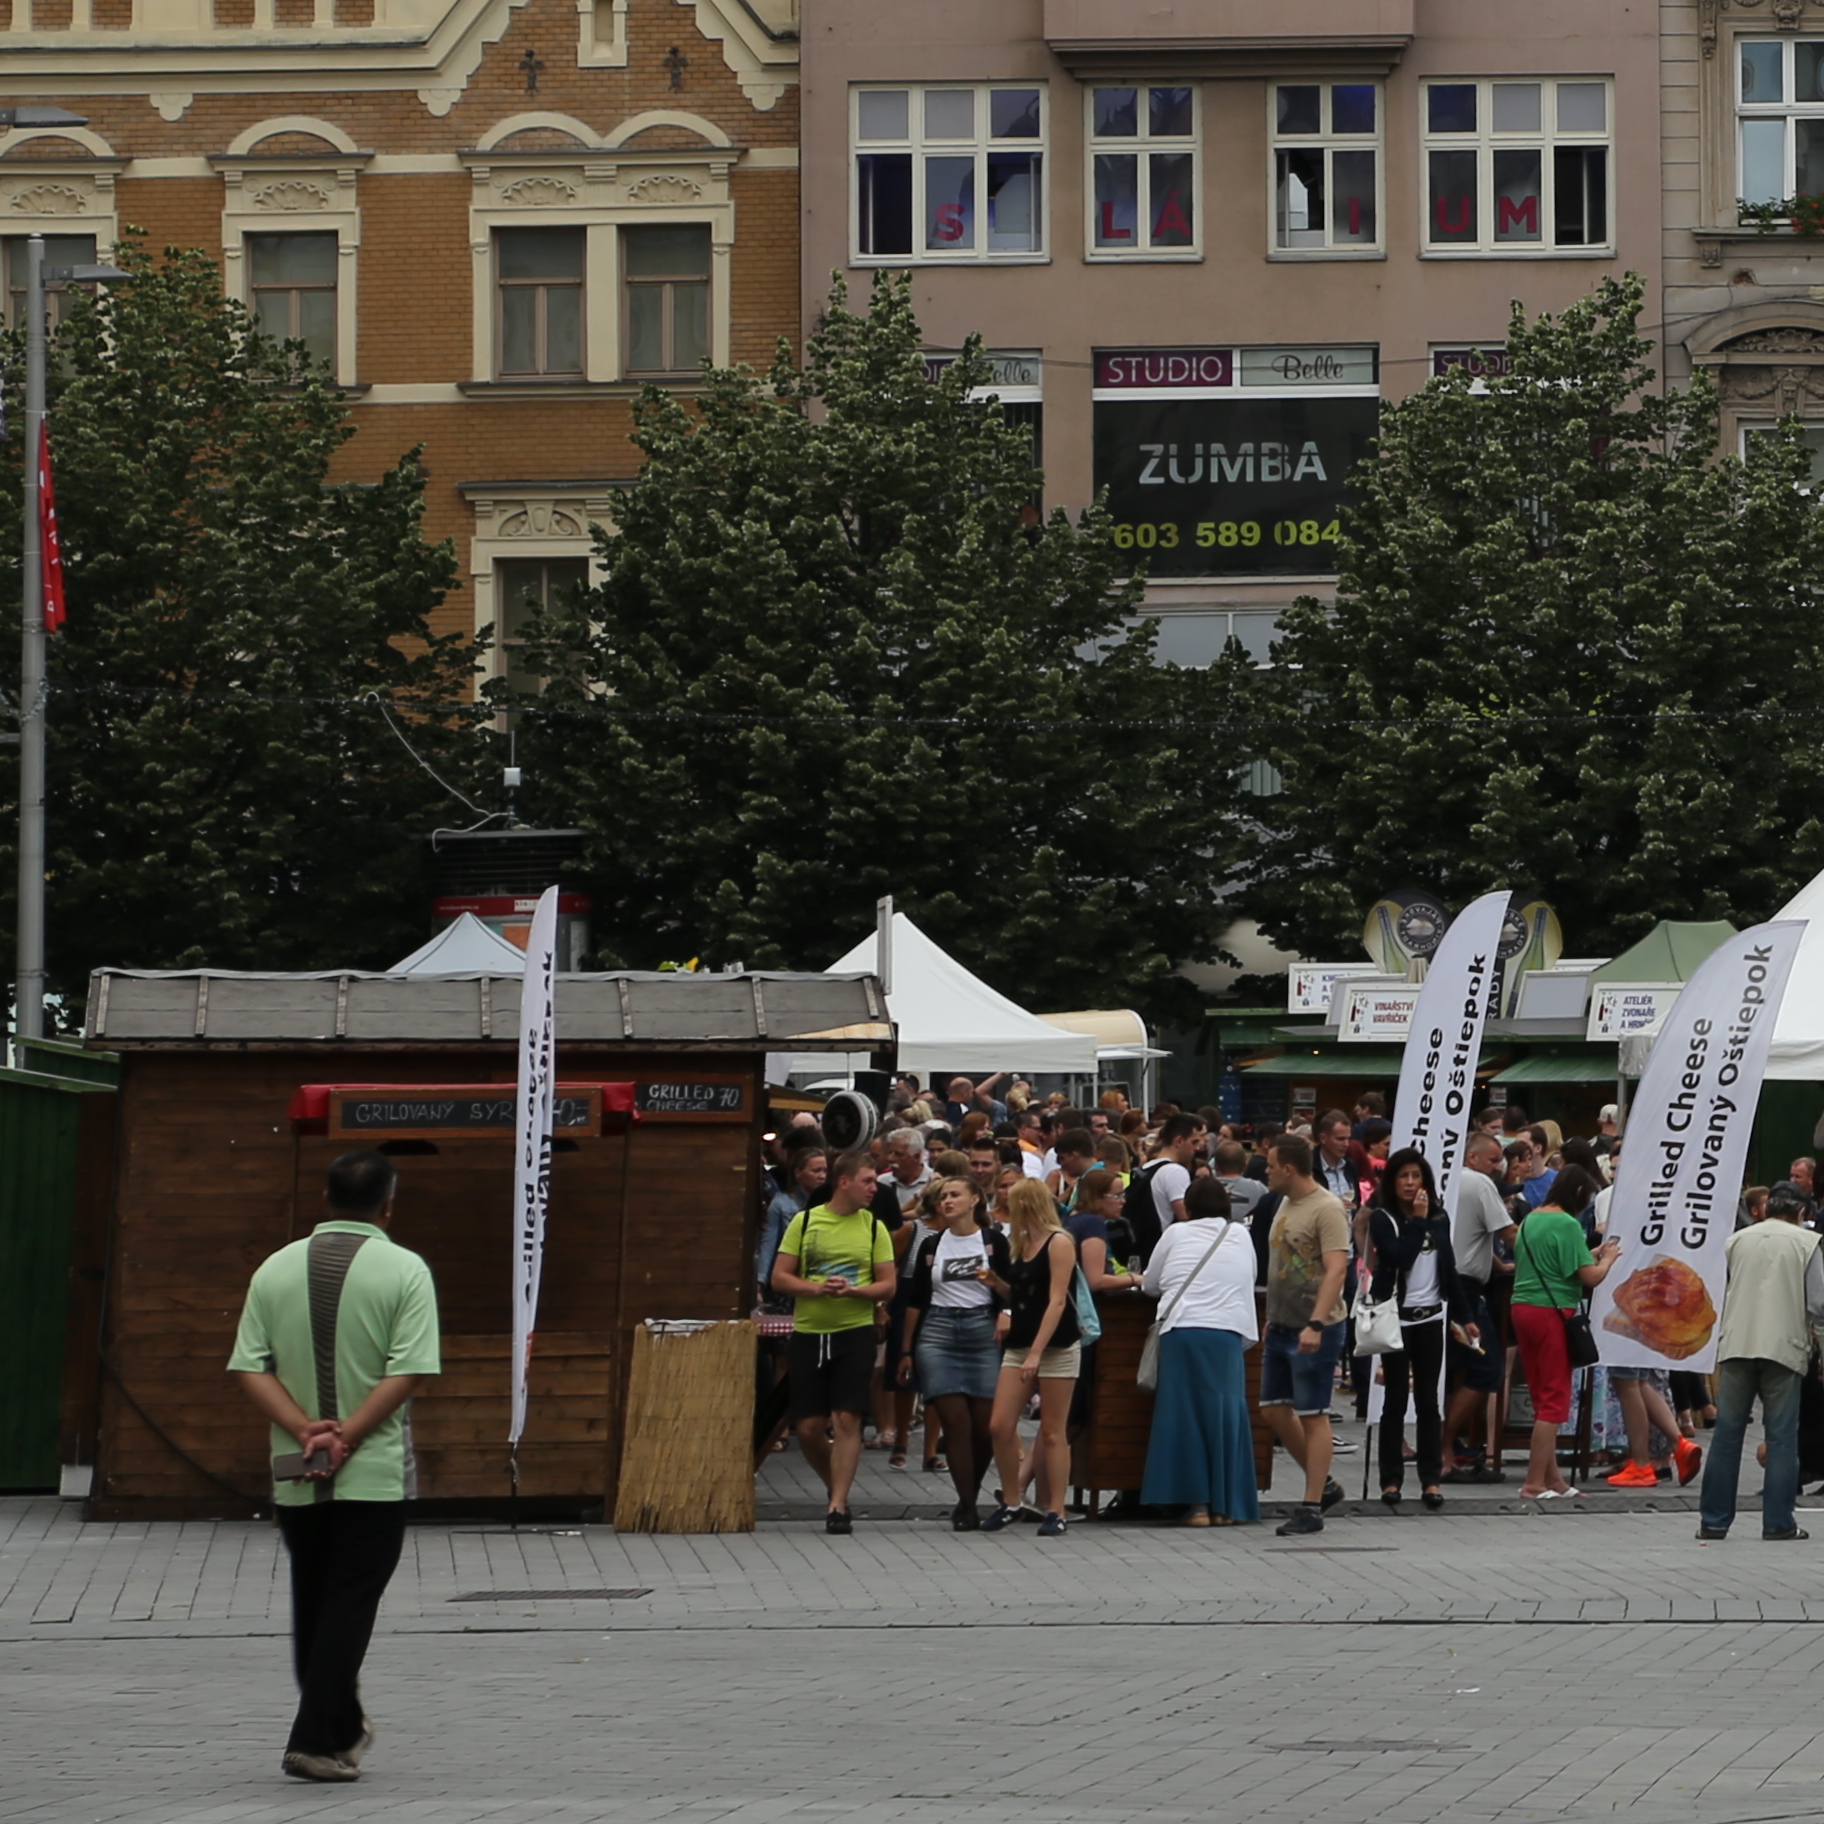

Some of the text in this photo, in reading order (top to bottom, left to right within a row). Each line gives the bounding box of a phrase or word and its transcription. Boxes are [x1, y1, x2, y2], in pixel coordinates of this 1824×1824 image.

[1108, 354, 1344, 383] STUDIO Belle
[1138, 441, 1327, 484] ZUMBA
[1113, 520, 1342, 549] 603 589 084
[1623, 994, 1653, 1006] ATELIÉR
[1444, 954, 1487, 1117] Oštiepok
[648, 1084, 714, 1101] GRILLED
[1680, 944, 1774, 1249] Grilovaný Oštiepok
[1640, 1018, 1712, 1245] Grilled Cheese
